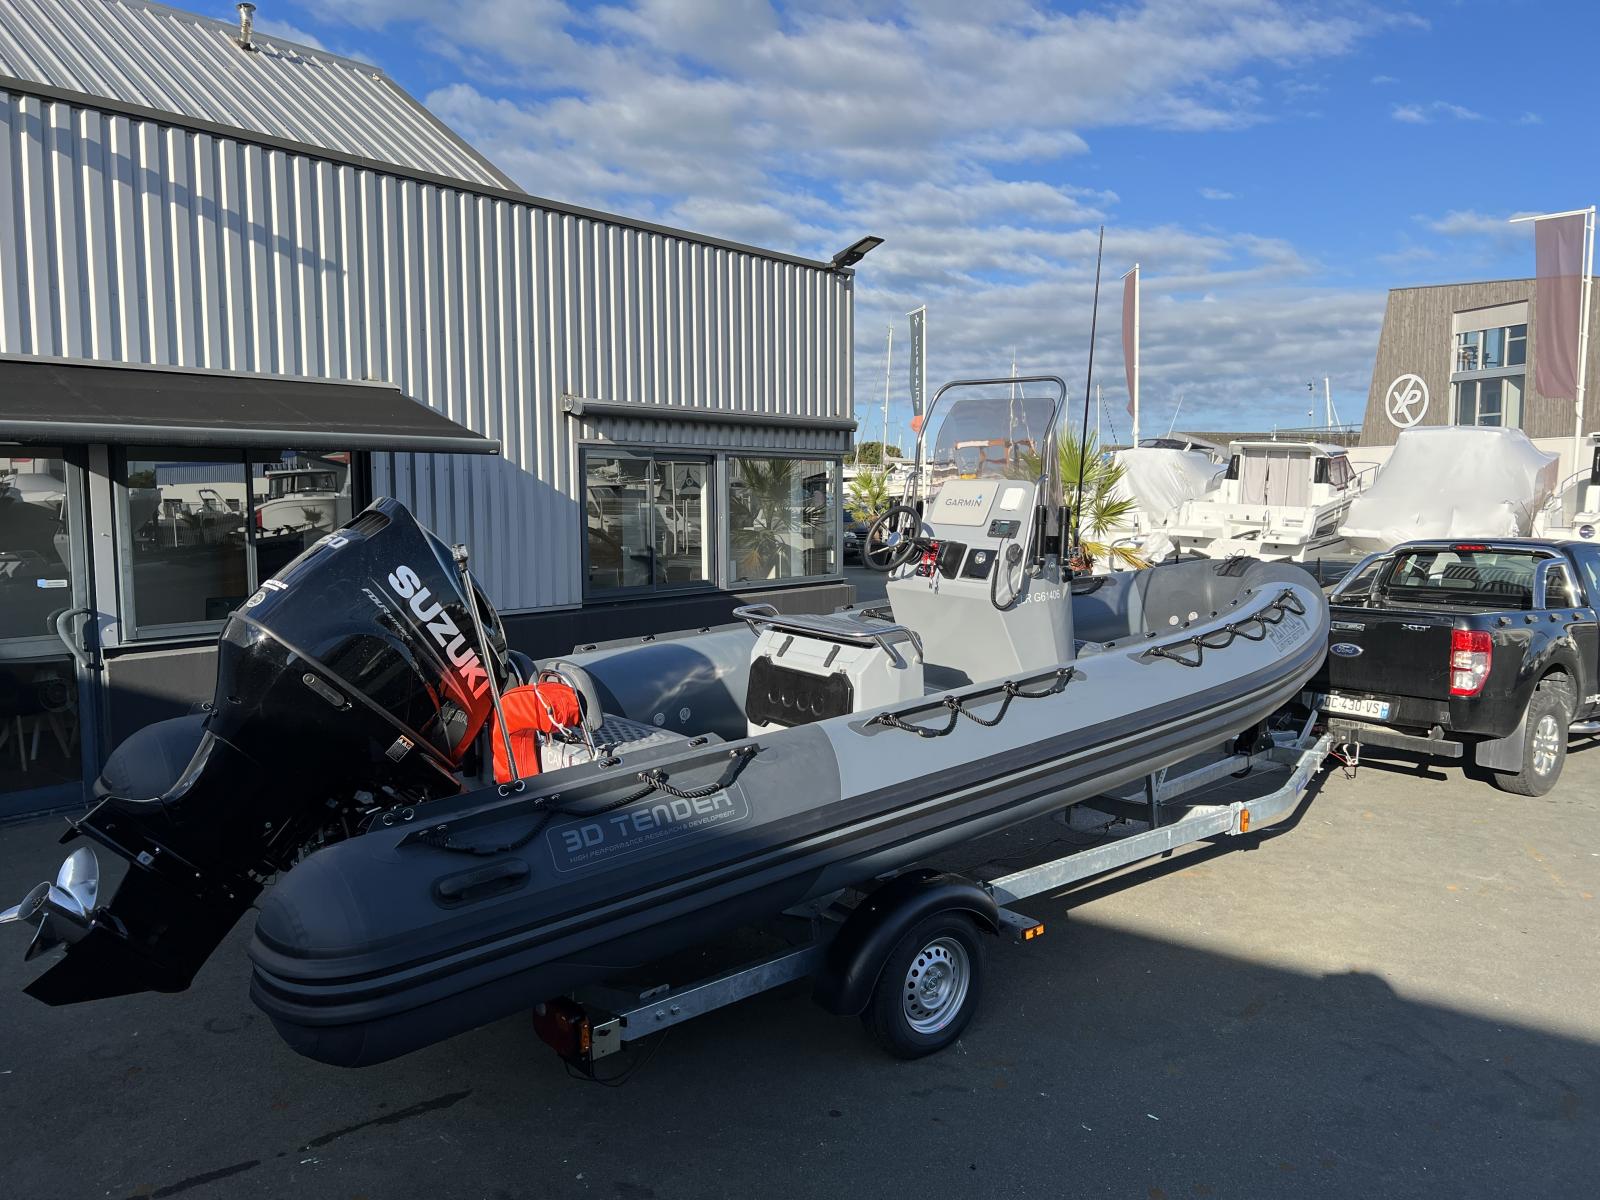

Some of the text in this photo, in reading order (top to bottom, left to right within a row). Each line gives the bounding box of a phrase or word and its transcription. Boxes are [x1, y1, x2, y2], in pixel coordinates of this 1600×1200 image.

[945, 498, 982, 507] GARMIN
[361, 587, 391, 615] FOUR
[388, 565, 490, 700] SUZUKI
[562, 790, 733, 852] 3D TENDER
[569, 853, 589, 863] HIGH
[590, 838, 643, 858] PERFORMANCE
[645, 825, 683, 841] RESEARCH
[688, 809, 737, 829] DEVELOPMENT
